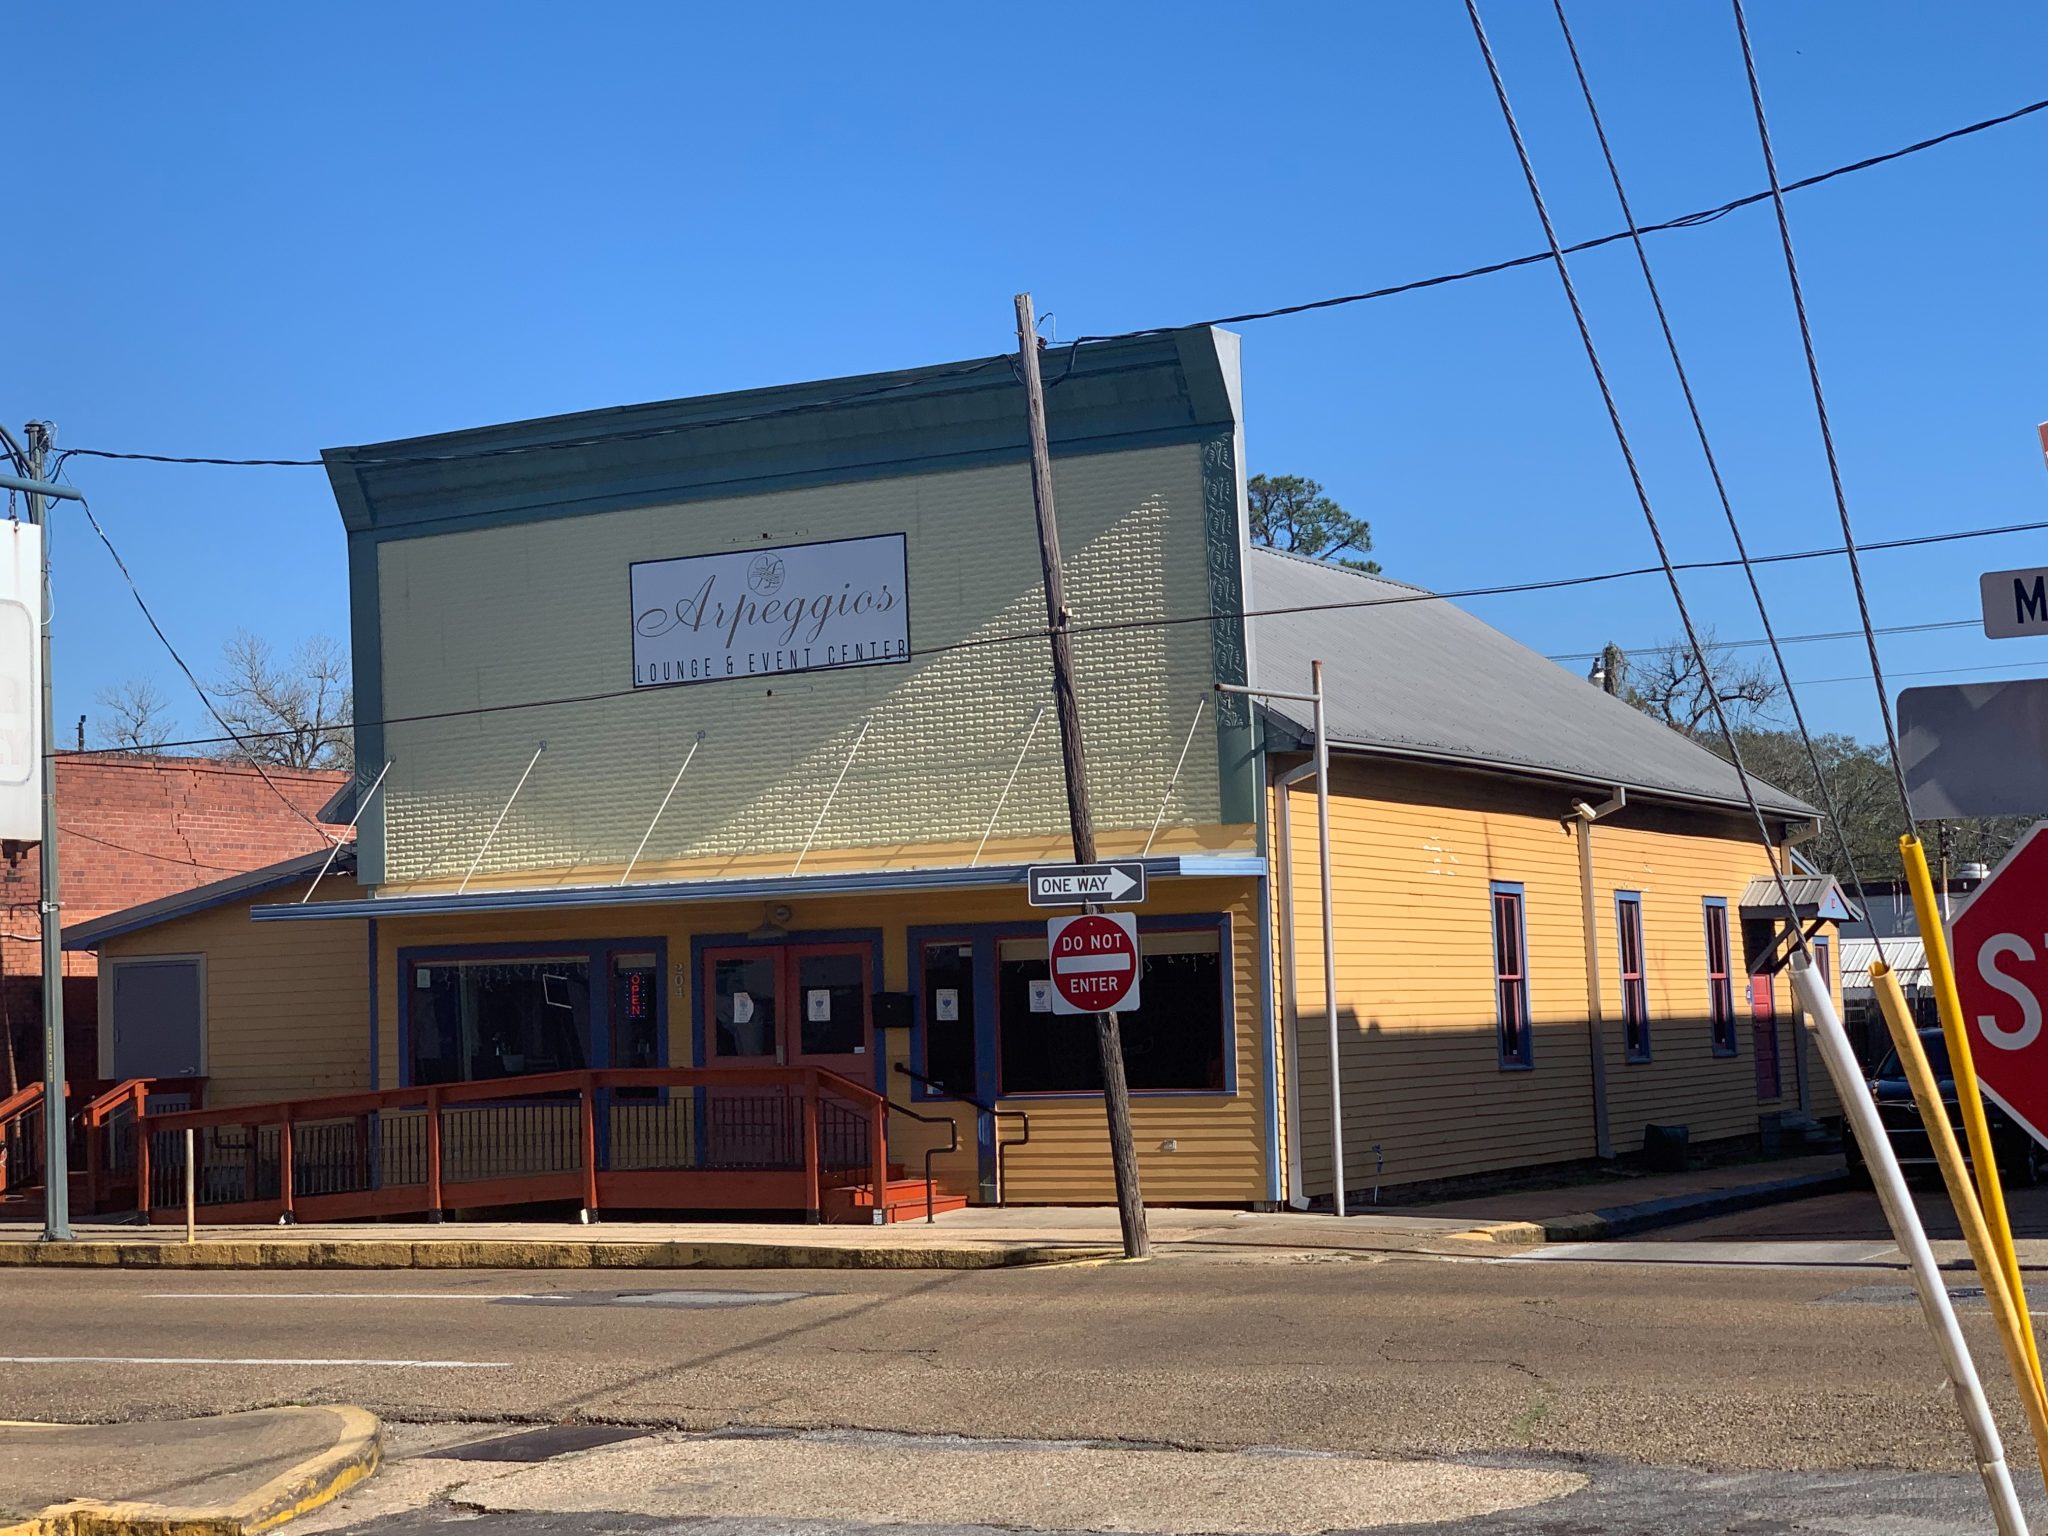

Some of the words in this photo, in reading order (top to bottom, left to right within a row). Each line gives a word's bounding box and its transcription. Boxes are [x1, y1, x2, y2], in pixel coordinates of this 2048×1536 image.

[636, 574, 902, 649] Arpeggios
[636, 657, 711, 684] LOUNGE
[726, 655, 735, 674] &
[748, 648, 811, 673] EVENT
[828, 639, 907, 666] CENTER
[1041, 878, 1072, 894] ONE
[1077, 876, 1109, 892] WAY
[1062, 935, 1084, 952] DO
[1090, 933, 1123, 949] NOT
[631, 974, 641, 1015] OPEN
[1070, 976, 1118, 993] ENTER
[1977, 932, 2048, 1051] S
